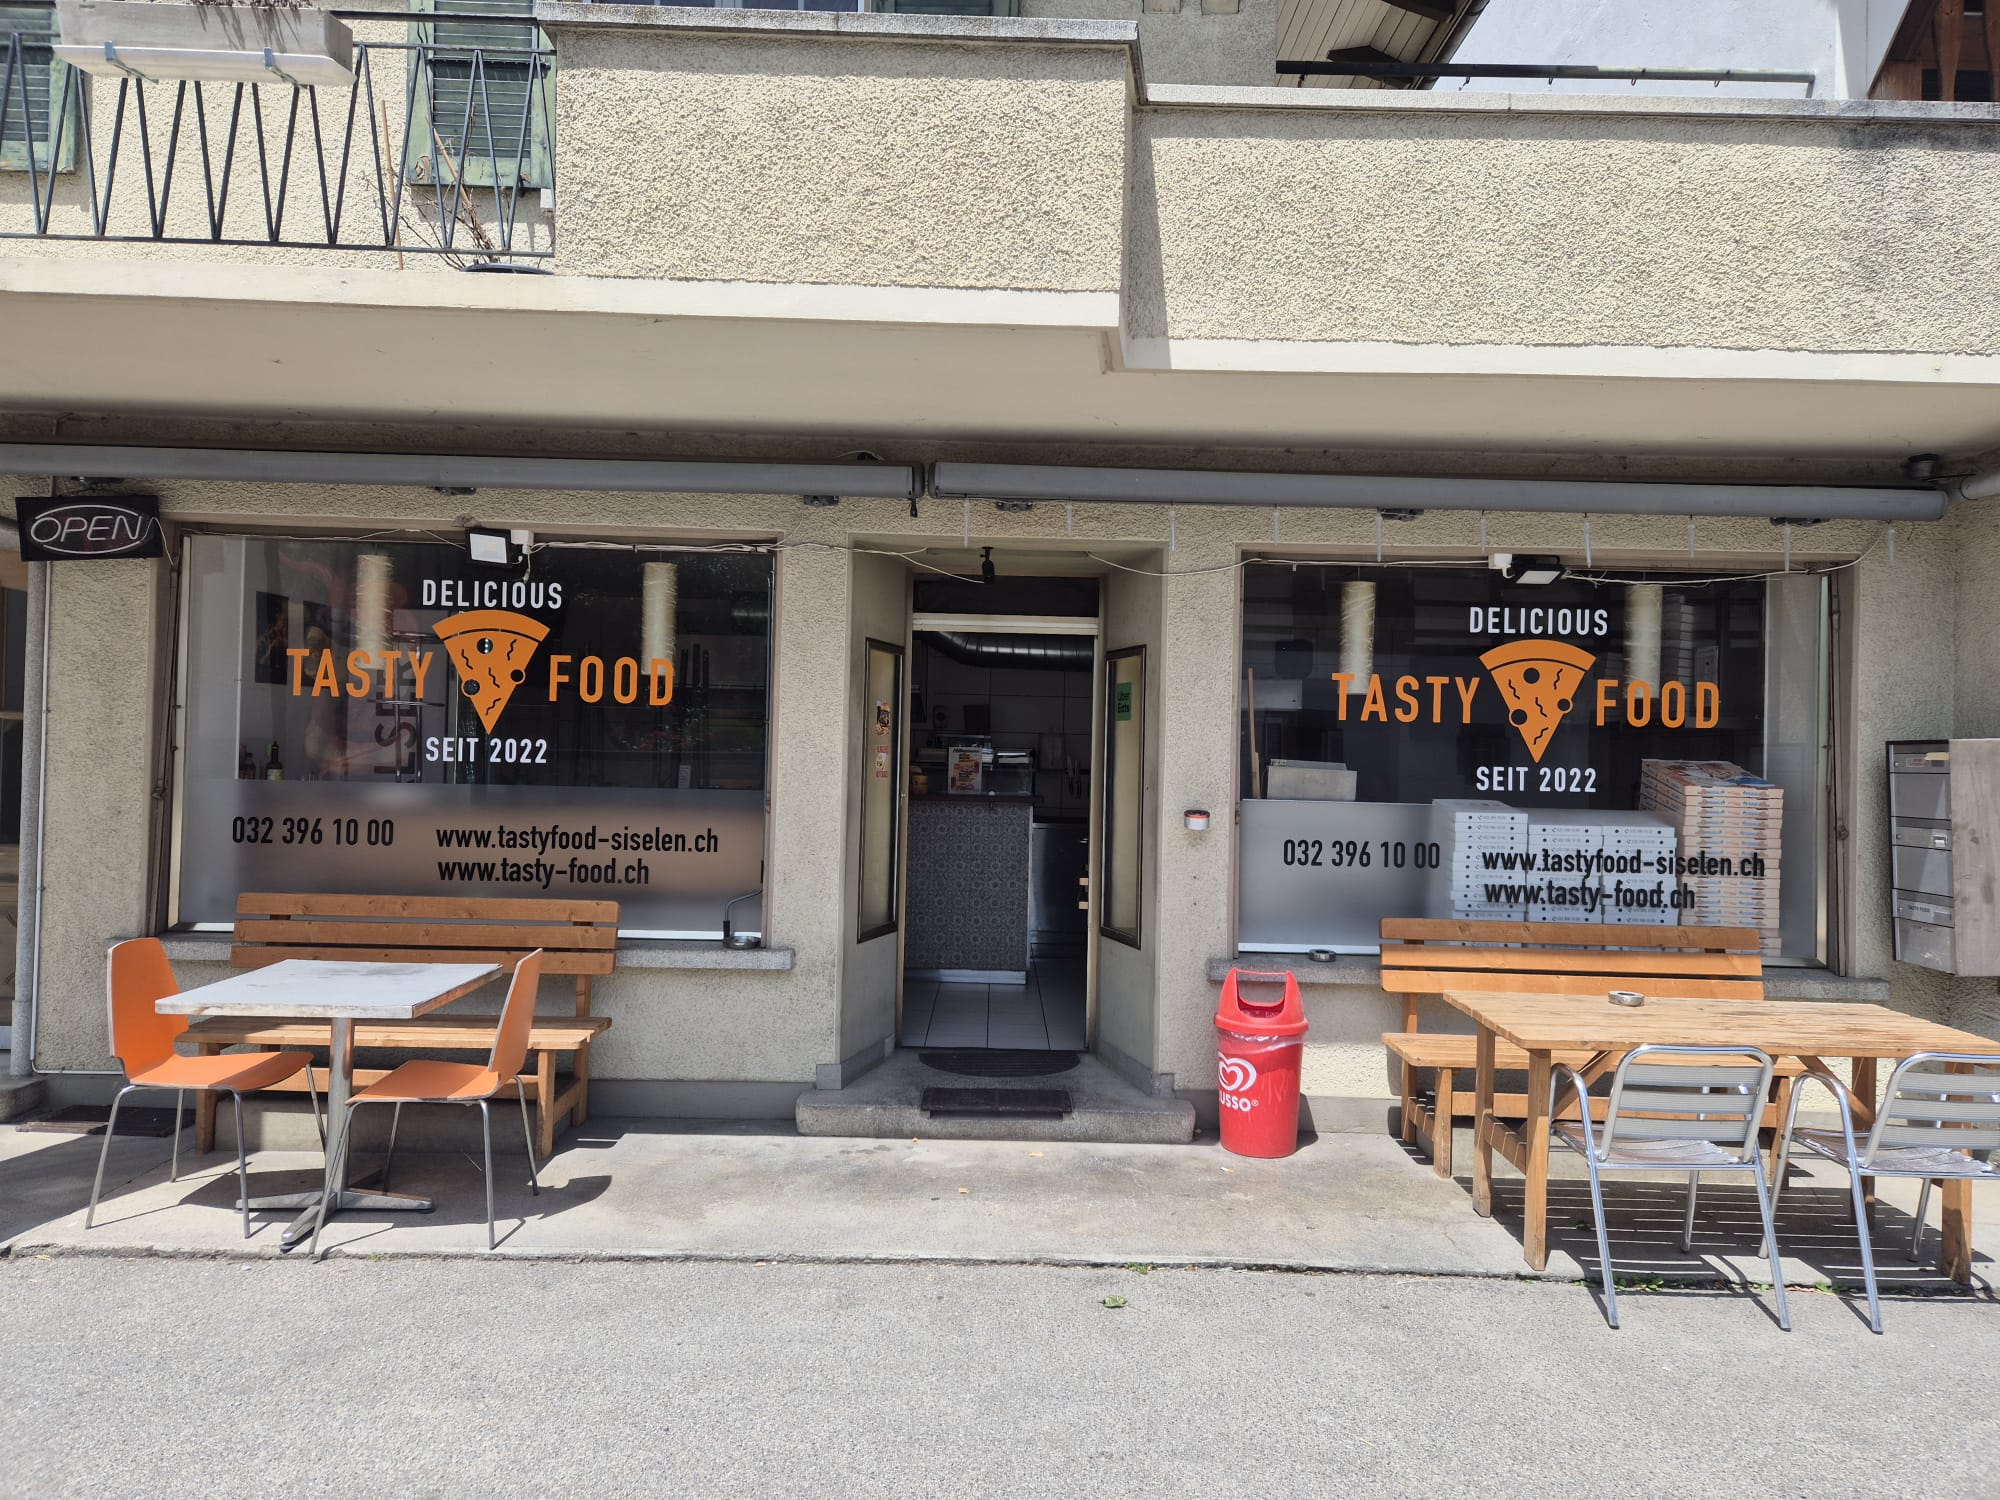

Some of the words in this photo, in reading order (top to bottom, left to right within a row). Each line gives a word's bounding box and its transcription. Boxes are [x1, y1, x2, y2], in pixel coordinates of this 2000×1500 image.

[31, 515, 142, 543] OPEN
[422, 579, 562, 609] DELICIOUS
[1469, 606, 1609, 636] DELICIOUS
[286, 648, 434, 699] TASTY
[548, 654, 675, 707] FOOD
[1331, 672, 1481, 724] TASTY
[1596, 679, 1720, 729] FOOD
[425, 737, 480, 763] SEIT
[490, 738, 548, 764] 2022
[1476, 766, 1529, 792] SEIT
[1539, 767, 1597, 793] 2022
[232, 816, 274, 844] 032
[282, 817, 324, 845] 396
[333, 818, 359, 846] 10
[367, 819, 394, 846] 00
[436, 825, 719, 855] www.tastyfood-siselen.ch
[1283, 839, 1323, 867] 032
[1331, 840, 1371, 868] 396
[1381, 841, 1406, 869] 10
[1414, 842, 1440, 869] 00
[1482, 848, 1765, 879] www.tastyfood-siselen.ch
[438, 857, 650, 889] www.tasty-food.ch
[1484, 880, 1695, 913] www.tasty-food.ch
[1218, 1090, 1252, 1112] USSO
